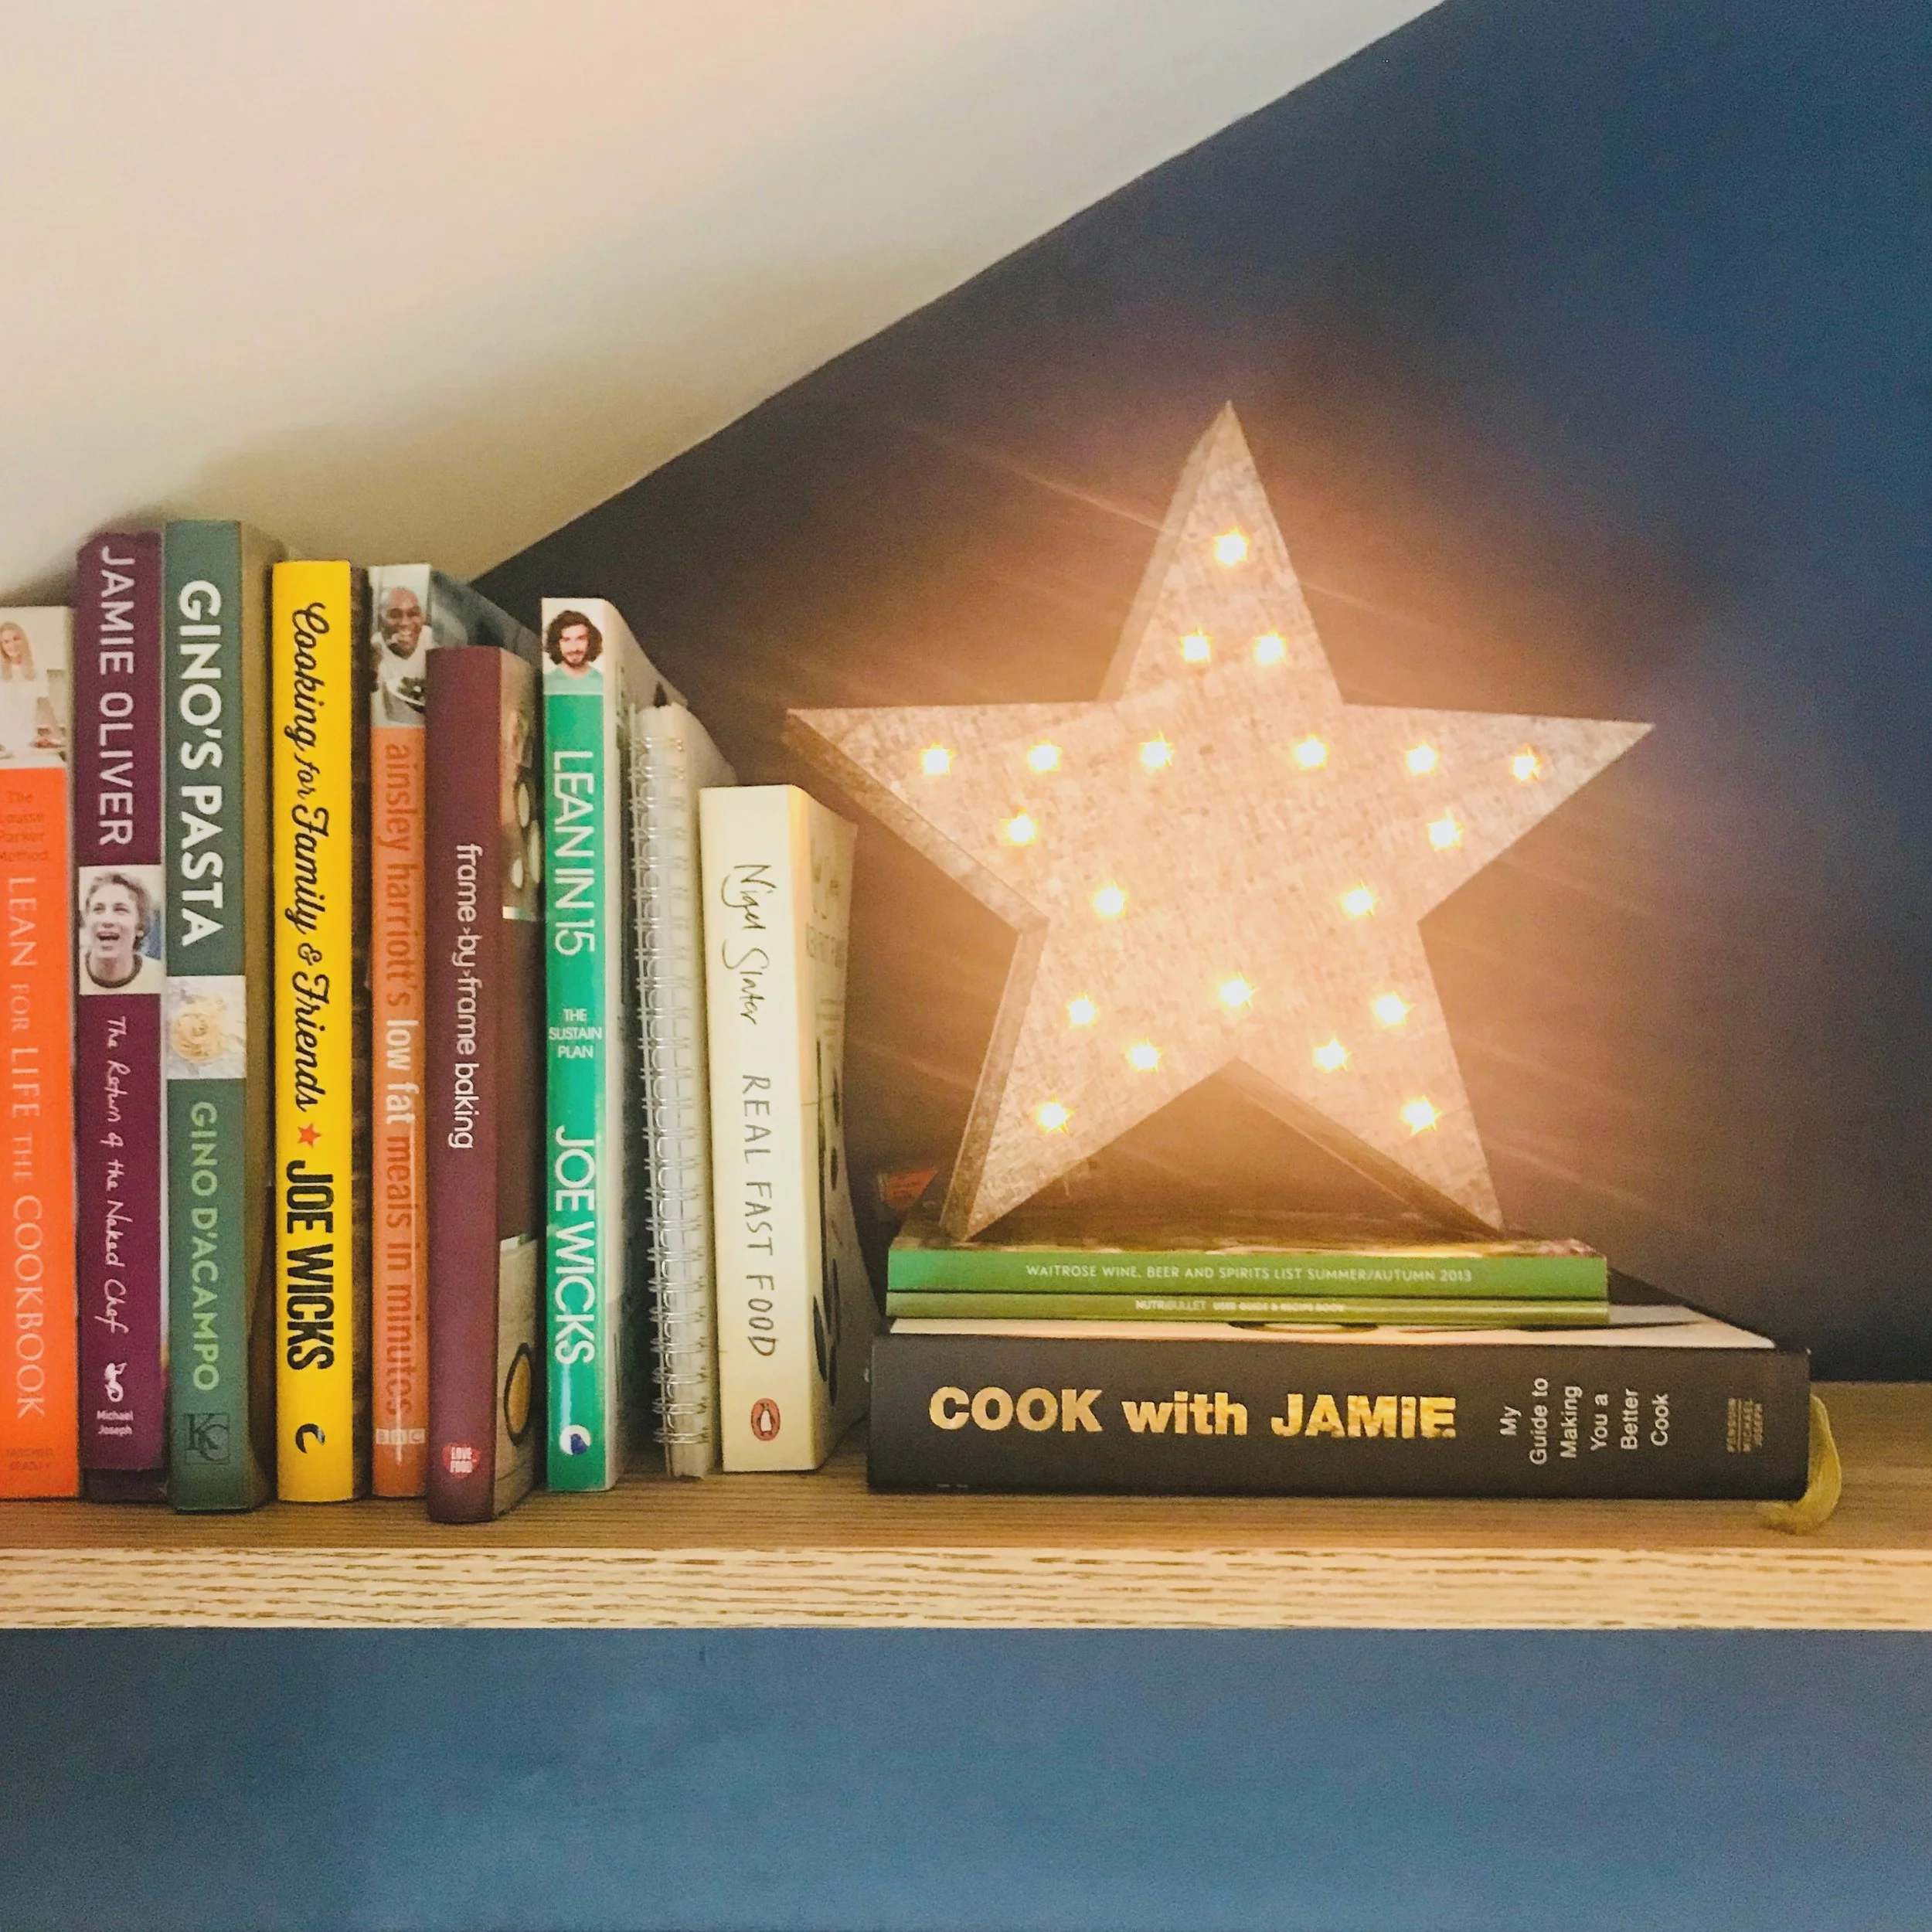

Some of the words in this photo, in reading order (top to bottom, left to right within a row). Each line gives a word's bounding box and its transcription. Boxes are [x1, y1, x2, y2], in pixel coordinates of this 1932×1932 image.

[99, 546, 135, 675] JAMIE
[179, 580, 223, 770] GINO'S
[284, 602, 330, 753] Cooking
[99, 692, 134, 845] OLIVER
[294, 754, 321, 804] for
[376, 743, 419, 852] ainsley
[553, 750, 595, 857] LEAN
[180, 785, 224, 947] PASTA
[284, 804, 330, 935] Family
[553, 868, 595, 909] IN
[721, 864, 777, 930] Nigel
[9, 877, 37, 967] LEAN
[298, 942, 322, 966] &
[386, 862, 420, 1007] harriott's
[554, 918, 595, 956] 15
[10, 983, 31, 1032] FOR
[107, 1015, 128, 1049] The
[548, 1026, 603, 1040] SUSTAIN
[563, 1009, 587, 1022] THE
[291, 971, 330, 1113] Friends
[386, 1019, 420, 1071] low
[556, 1045, 594, 1059] PLAN
[12, 1047, 39, 1118] LIFE
[104, 1060, 131, 1122] Return
[386, 1082, 420, 1124] fat
[447, 1063, 480, 1150] baking
[190, 1100, 218, 1197] GINO
[742, 1074, 772, 1164] REAL
[12, 1131, 33, 1182] THE
[106, 1159, 125, 1192] the
[386, 1135, 418, 1229] meals
[555, 1124, 595, 1212] JOE
[286, 1159, 335, 1235] JOE
[744, 1181, 774, 1256] FAST
[105, 1199, 134, 1267] Naked
[386, 1242, 421, 1271] in
[13, 1195, 46, 1419] COOKBOOK
[94, 1278, 129, 1334] Chef
[191, 1207, 220, 1391] D'ACAMPO
[287, 1243, 335, 1370] WICKS
[554, 1220, 596, 1365] WICKS
[1026, 1264, 1097, 1279] WAITROSE
[1146, 1266, 1179, 1280] BEER
[1184, 1267, 1213, 1280] AND
[1219, 1267, 1270, 1281] SPIRITS
[1274, 1267, 1302, 1281] LIST
[1307, 1268, 1435, 1283] SUMMER/AUTUMN
[746, 1274, 777, 1356] FOOD
[386, 1284, 421, 1415] minutes
[929, 1386, 1103, 1432] COOK
[1121, 1390, 1248, 1436] with
[1270, 1393, 1457, 1439] JAMIE
[1499, 1406, 1522, 1436] My
[1531, 1377, 1549, 1398] to
[1559, 1384, 1583, 1459] Making
[1594, 1393, 1609, 1406] a
[1621, 1388, 1639, 1451] Better
[1651, 1392, 1670, 1447] Cook
[1529, 1403, 1549, 1465] Guide
[1590, 1413, 1609, 1451] You
